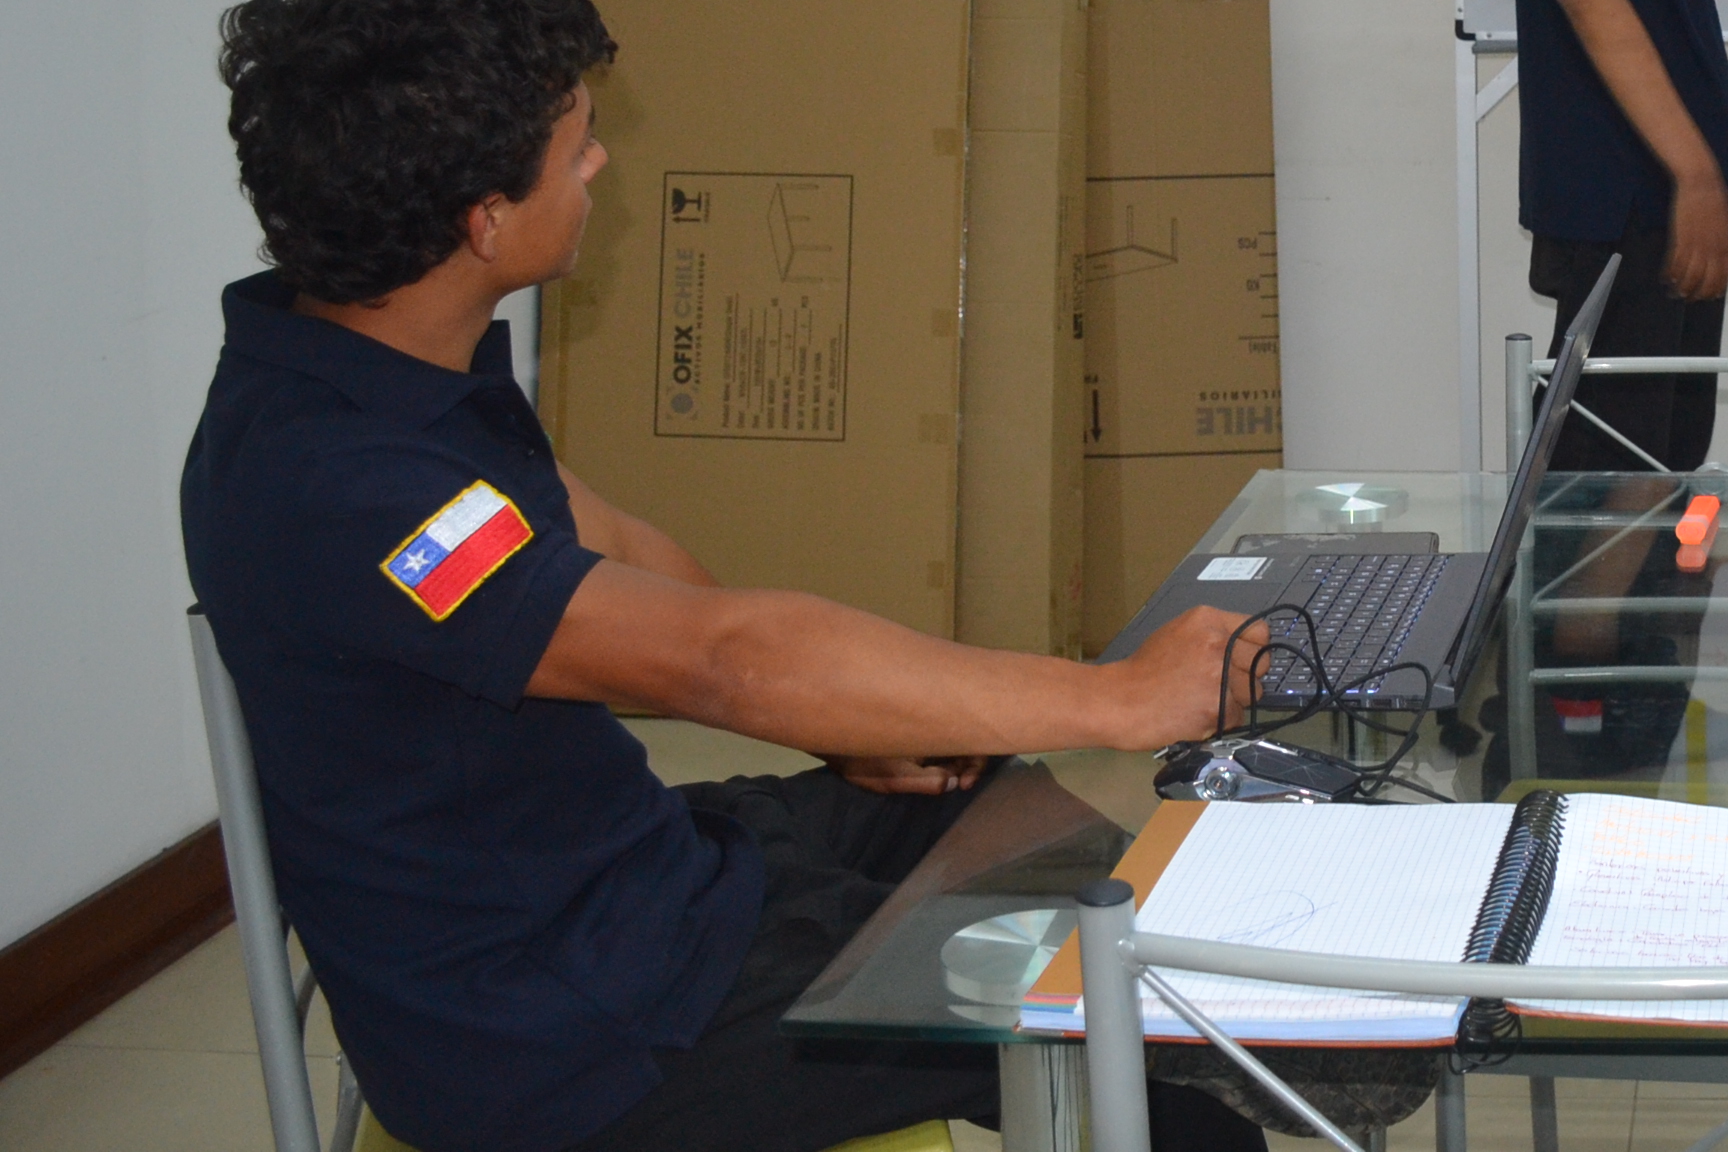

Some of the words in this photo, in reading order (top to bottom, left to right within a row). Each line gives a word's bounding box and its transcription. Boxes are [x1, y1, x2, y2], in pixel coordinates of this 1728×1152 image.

[673, 248, 694, 319] CHILE
[673, 325, 694, 385] OFIX
[1196, 406, 1283, 437] HILE
